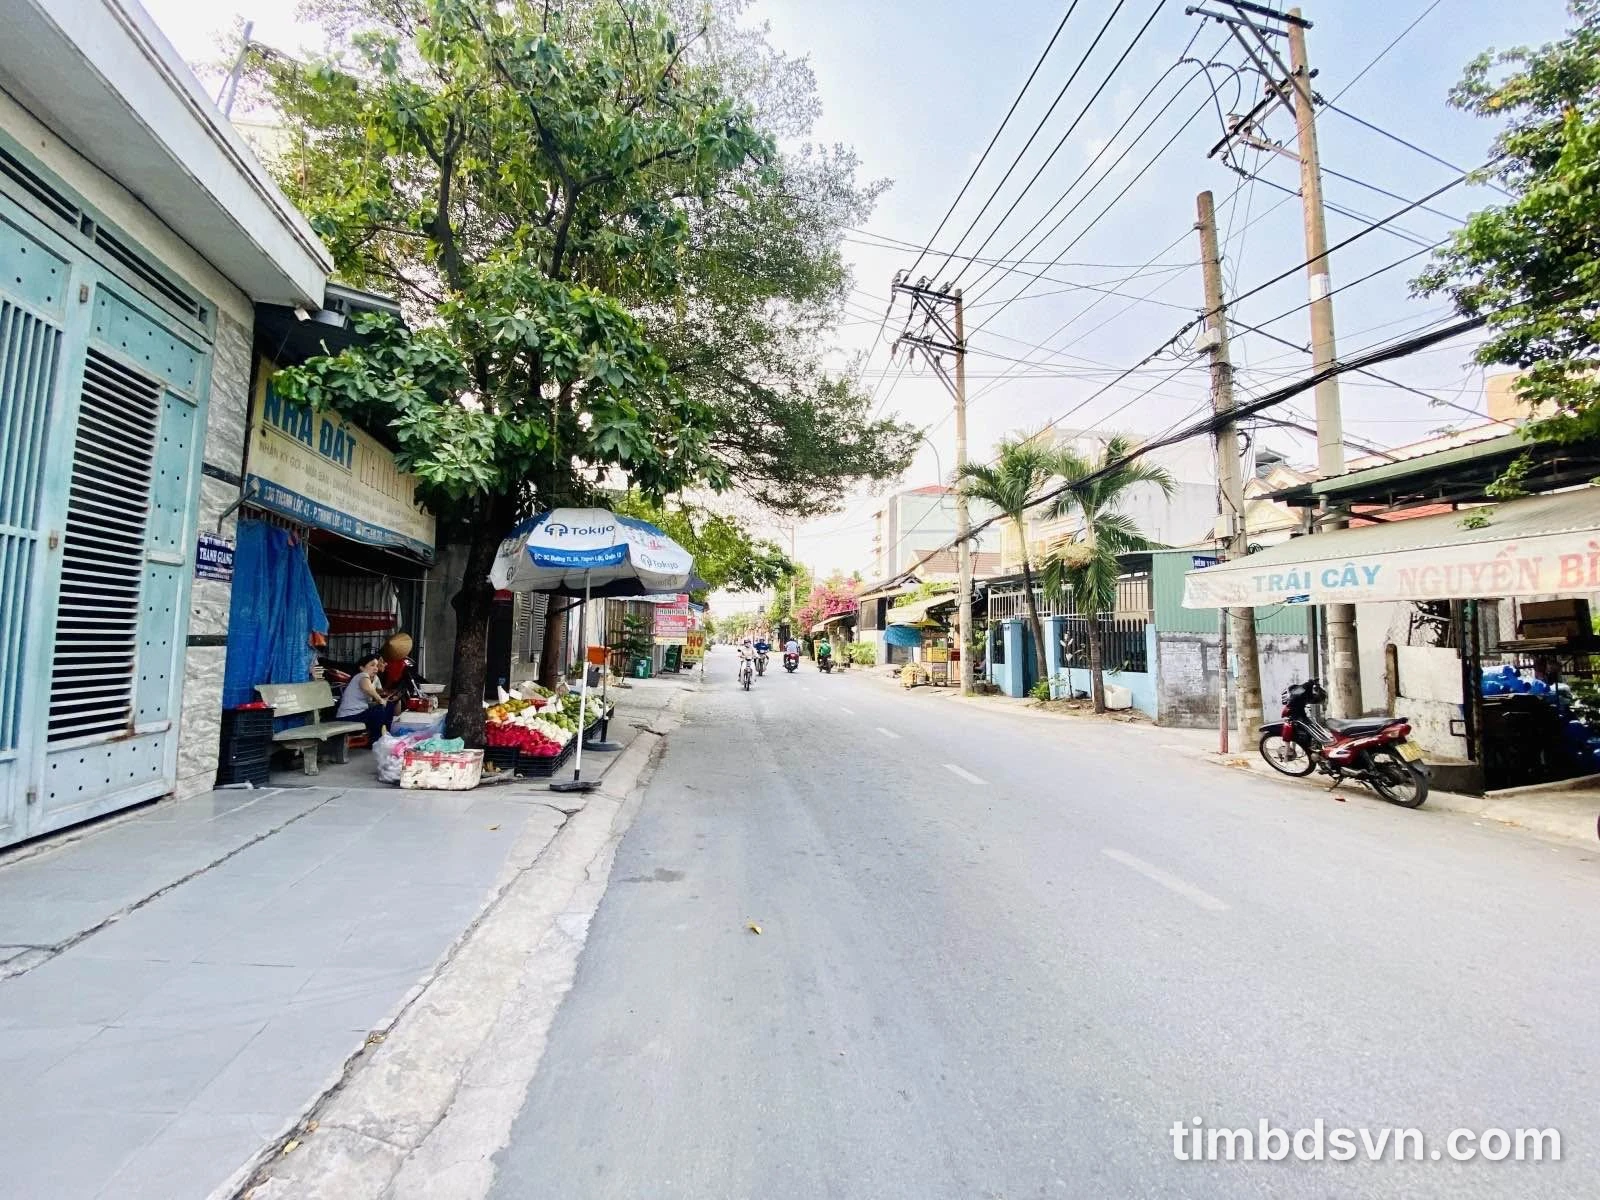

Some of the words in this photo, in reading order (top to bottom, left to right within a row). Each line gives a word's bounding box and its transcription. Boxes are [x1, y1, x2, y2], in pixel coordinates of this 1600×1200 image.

[1251, 567, 1311, 593] TRÁI
[1320, 561, 1382, 588] CÂY
[1399, 545, 1543, 595] NGUYỄN
